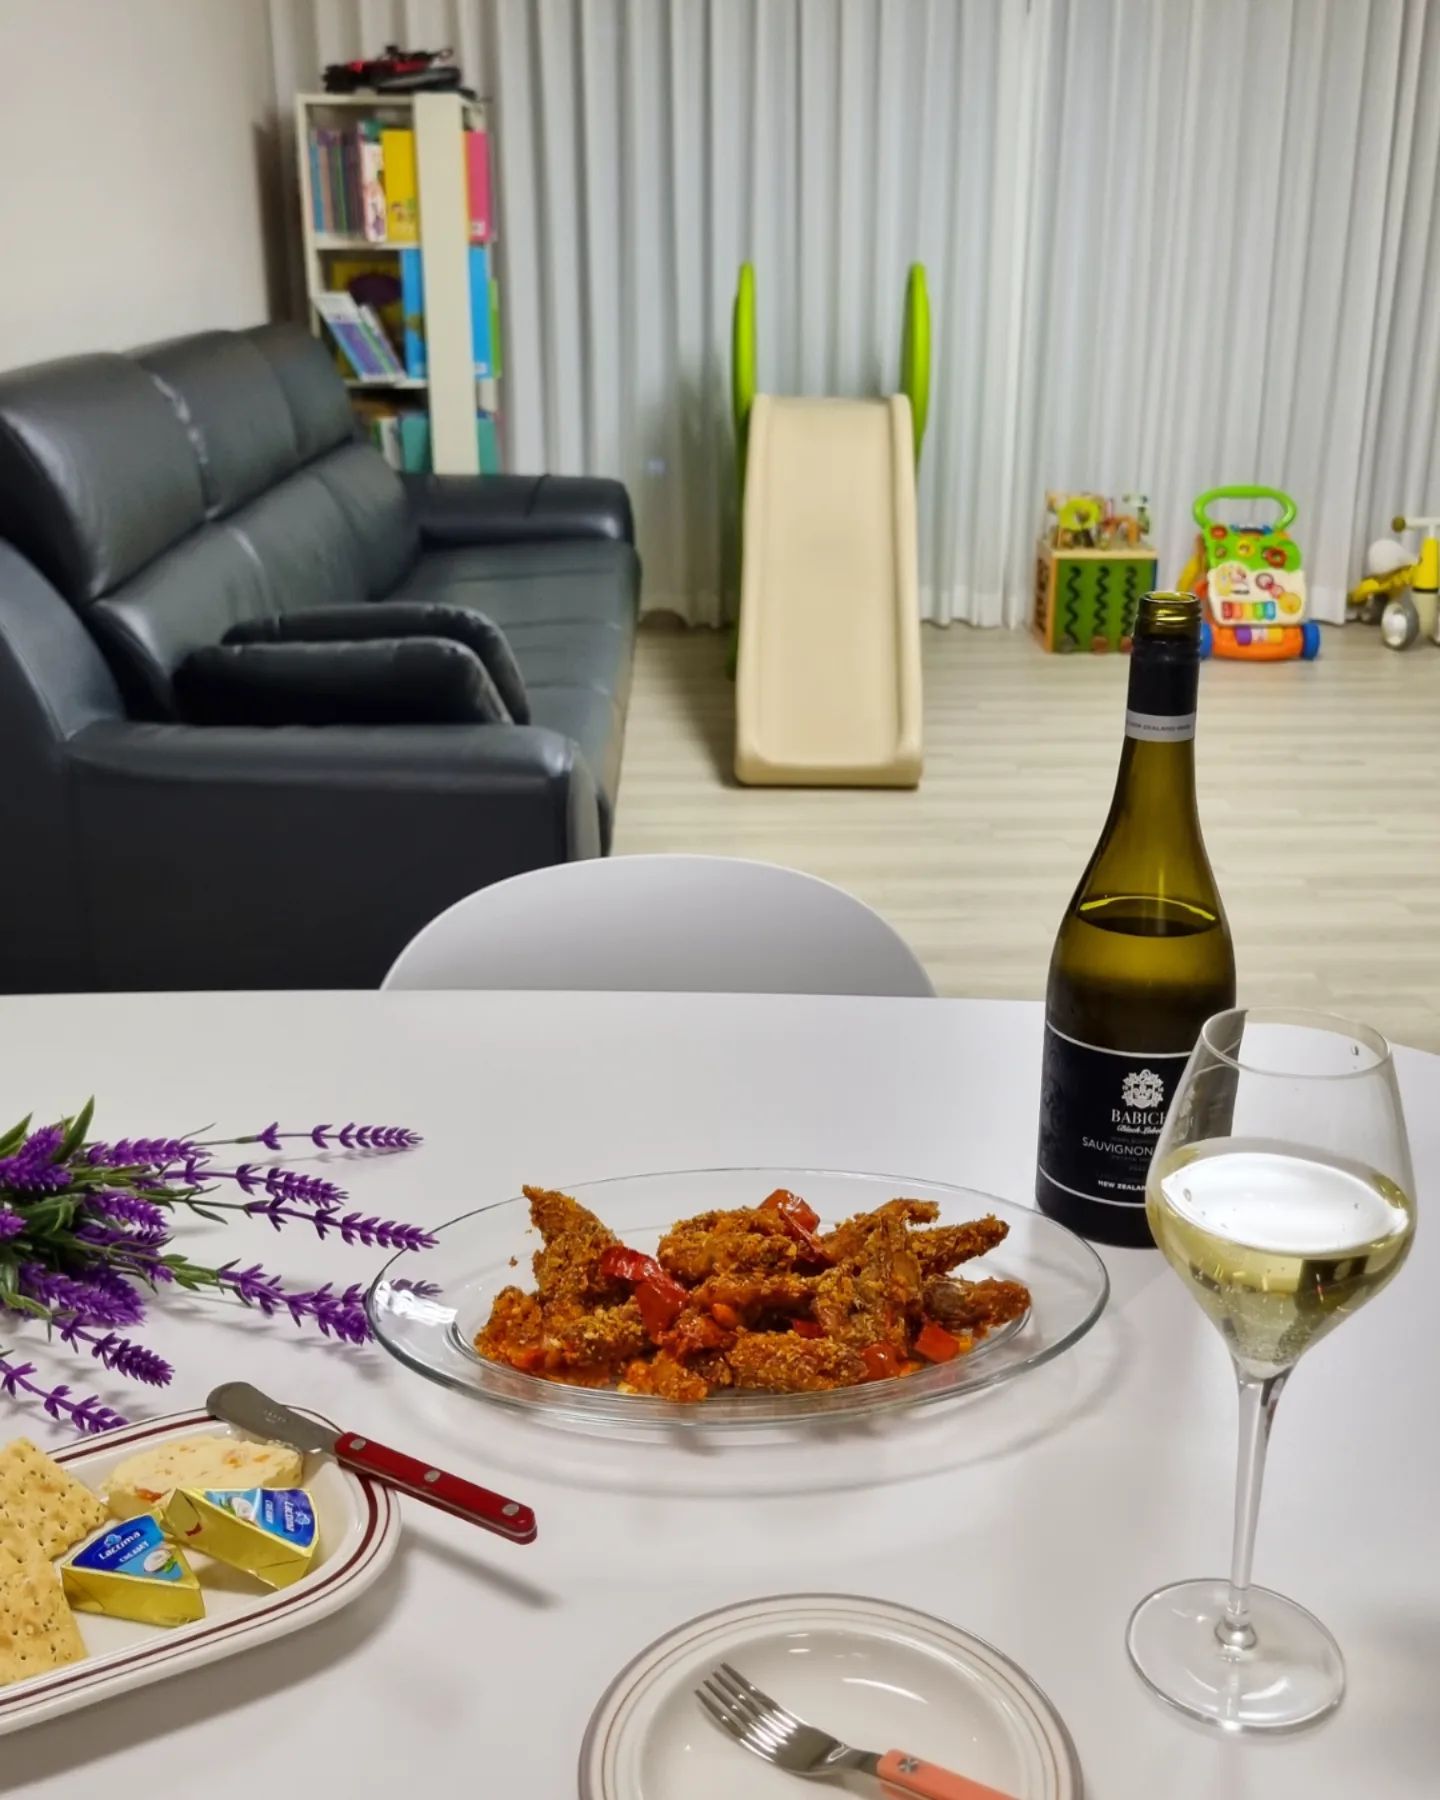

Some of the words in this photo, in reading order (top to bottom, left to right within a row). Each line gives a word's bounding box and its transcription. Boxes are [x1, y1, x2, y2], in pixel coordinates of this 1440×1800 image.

[1082, 1137, 1153, 1156] SAUVIGNON
[1098, 1180, 1115, 1188] NEW
[1117, 1183, 1147, 1191] ZEALAN
[98, 1531, 141, 1560] Lactima
